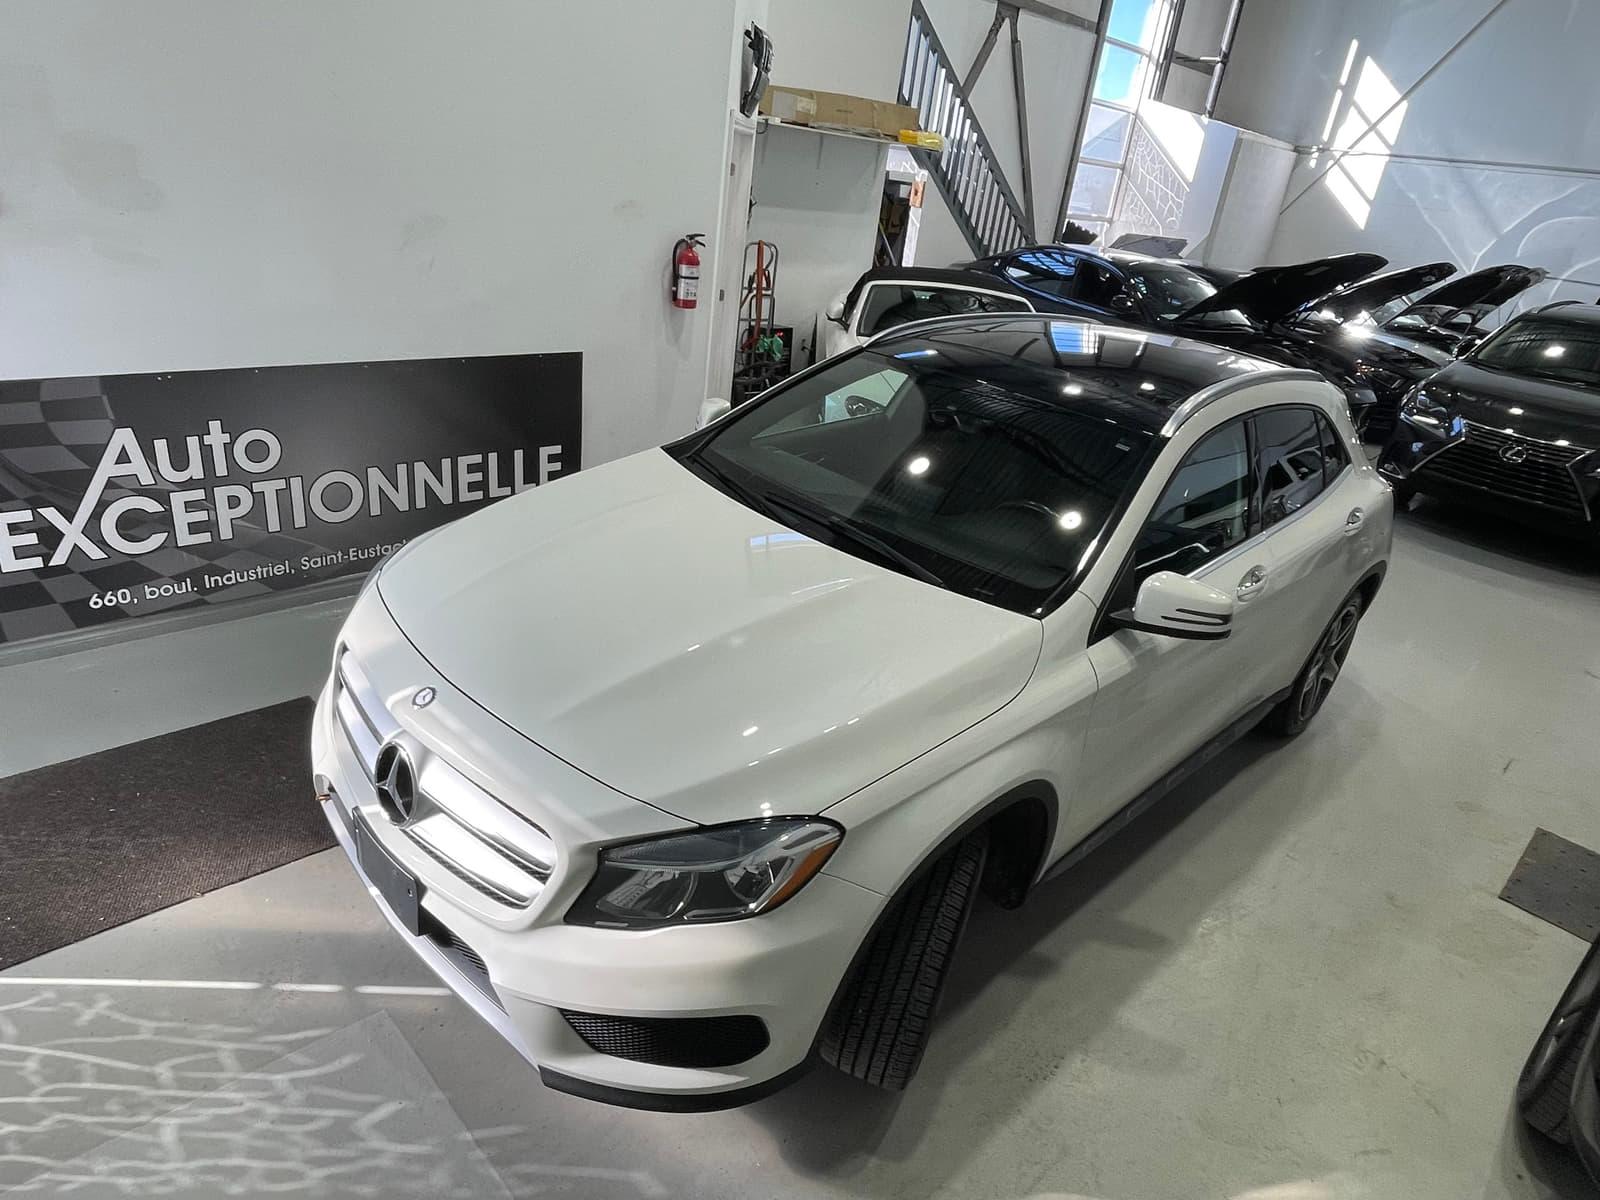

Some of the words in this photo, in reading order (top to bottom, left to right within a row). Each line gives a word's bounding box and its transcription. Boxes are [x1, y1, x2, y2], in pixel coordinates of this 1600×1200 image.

[100, 420, 282, 487] Auto
[0, 445, 562, 574] EXCEPTIONNELLE
[89, 588, 138, 610] 660,
[144, 577, 198, 600] boul.
[204, 560, 295, 589] Industriel,
